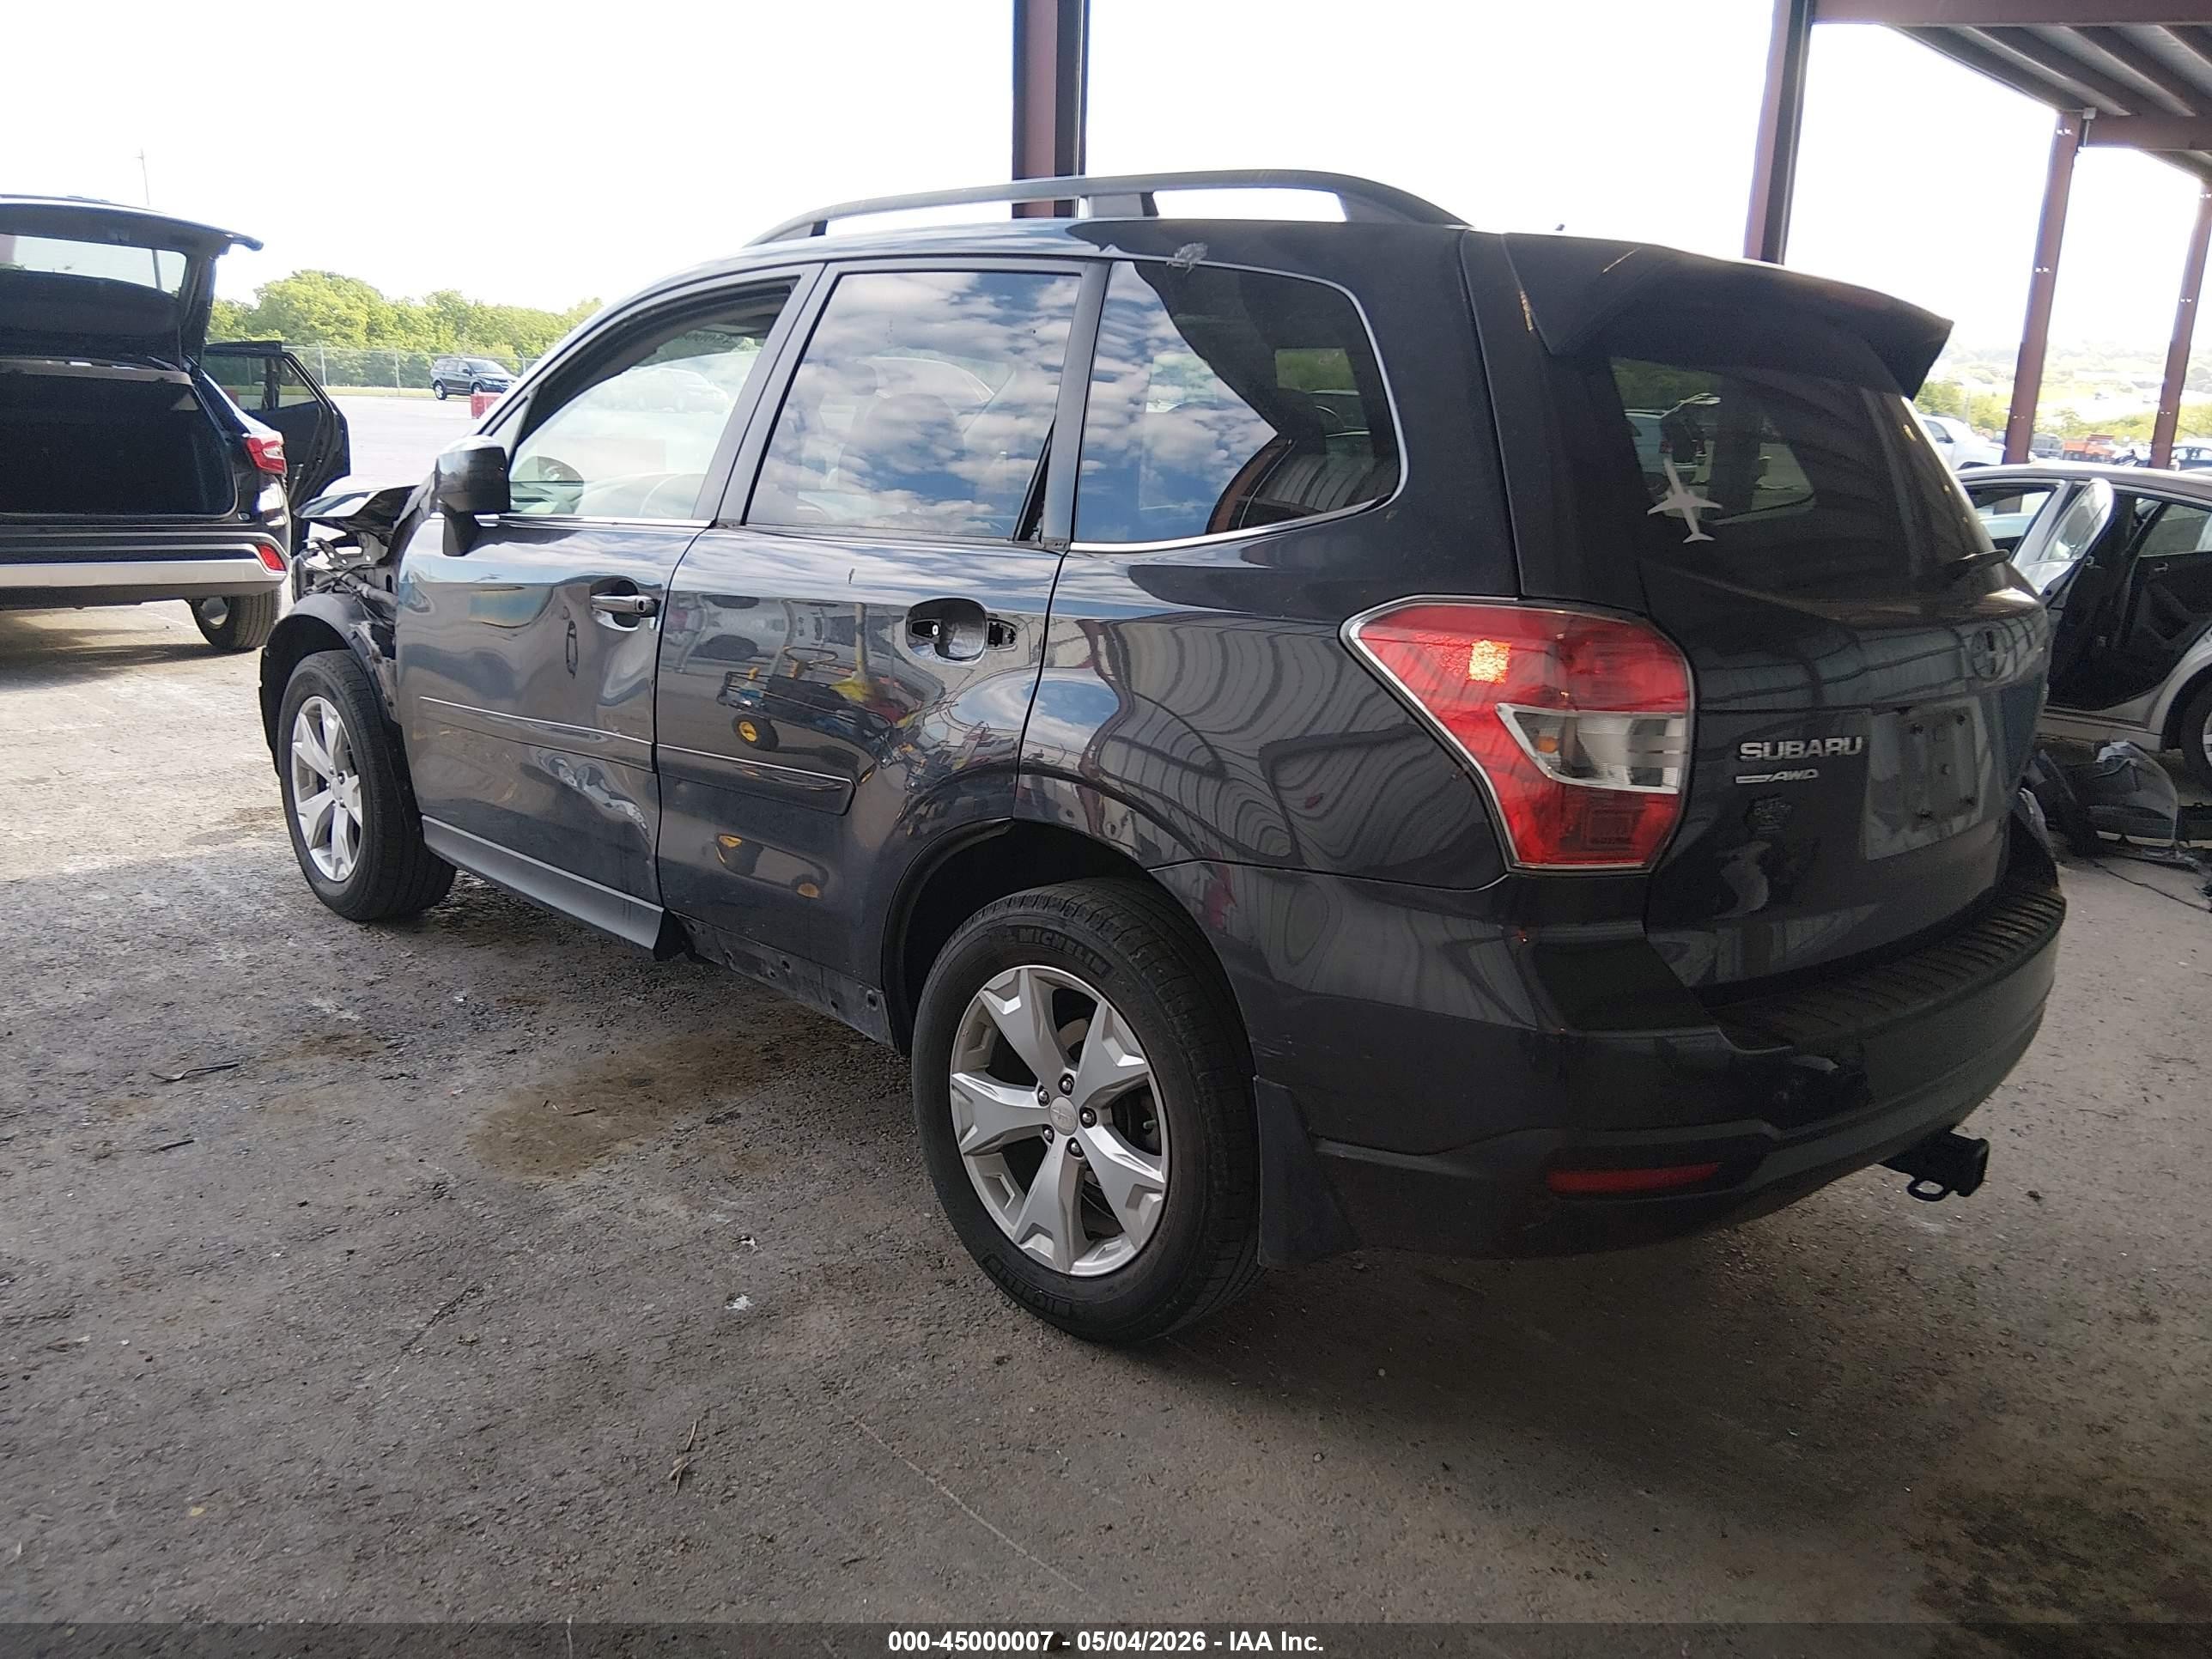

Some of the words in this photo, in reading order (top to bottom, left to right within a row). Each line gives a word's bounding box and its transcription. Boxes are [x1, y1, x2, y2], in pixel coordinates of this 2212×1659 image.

[1740, 737, 1862, 761] SUBARU
[1769, 769, 1819, 781] AWD
[1019, 927, 1108, 975] MICHELIN
